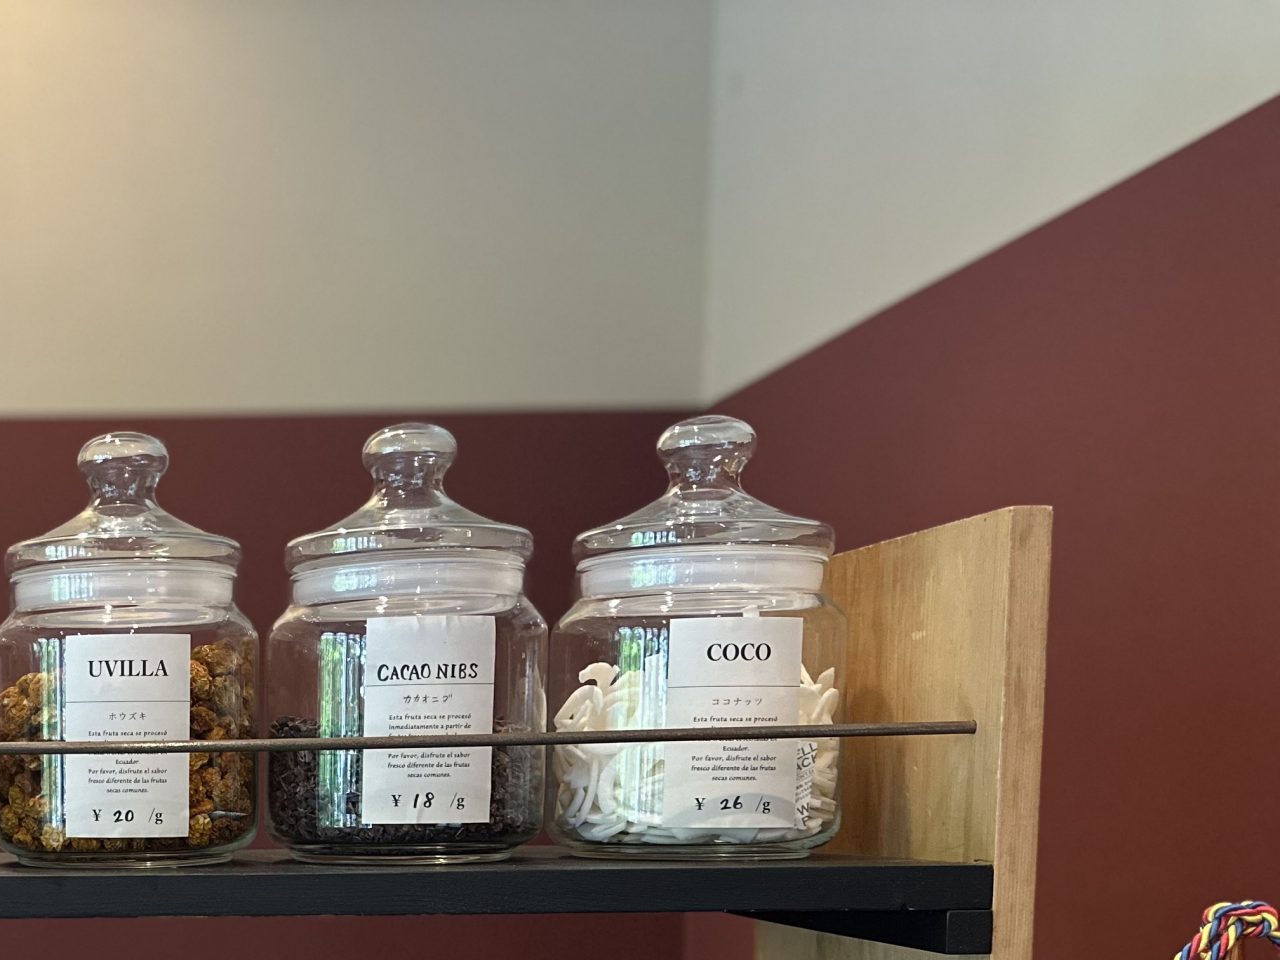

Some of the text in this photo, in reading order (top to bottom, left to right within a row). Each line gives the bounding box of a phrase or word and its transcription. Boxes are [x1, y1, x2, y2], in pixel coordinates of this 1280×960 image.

[707, 643, 771, 661] COCO
[88, 660, 168, 677] UVILLA
[377, 663, 478, 681] CACAO NIBS
[712, 698, 763, 706] ココナッツ
[414, 792, 434, 808] 18
[720, 796, 743, 810] 26
[113, 810, 134, 823] 20
